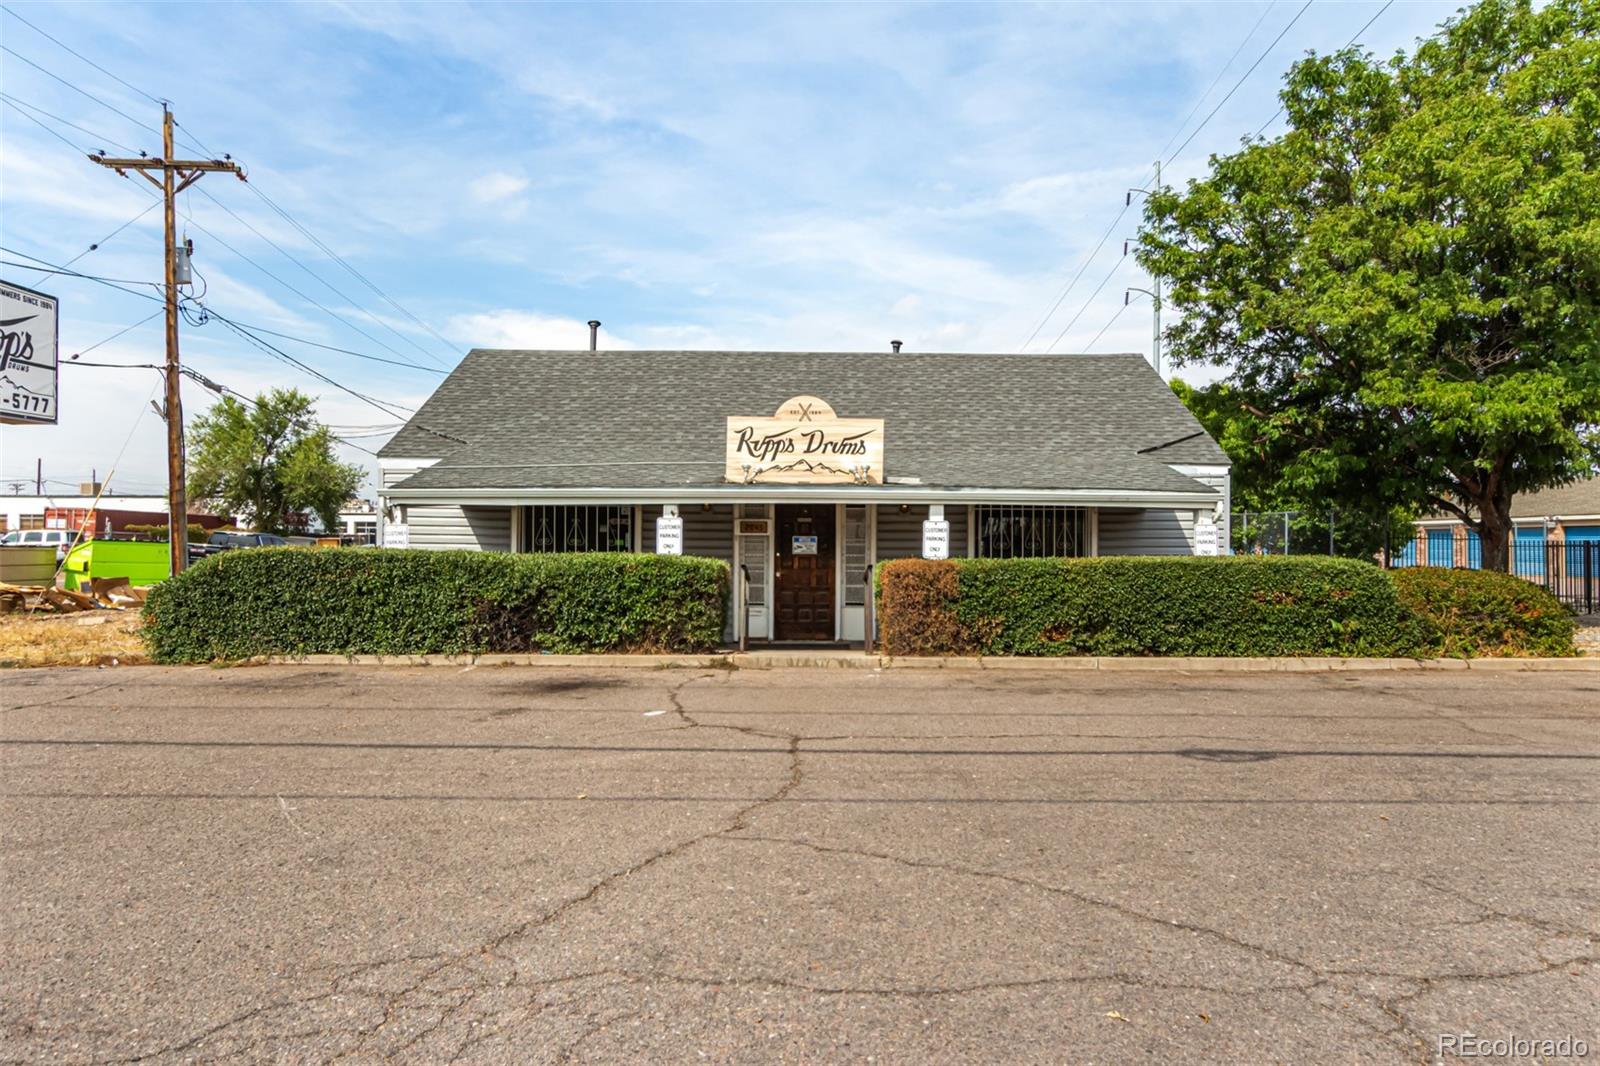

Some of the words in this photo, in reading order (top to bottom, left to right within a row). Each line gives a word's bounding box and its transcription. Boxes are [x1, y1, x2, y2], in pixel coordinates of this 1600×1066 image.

[22, 295, 38, 306] SINCE
[8, 361, 30, 373] DRUMS
[733, 426, 799, 462] Rupp's
[801, 428, 876, 456] Drums
